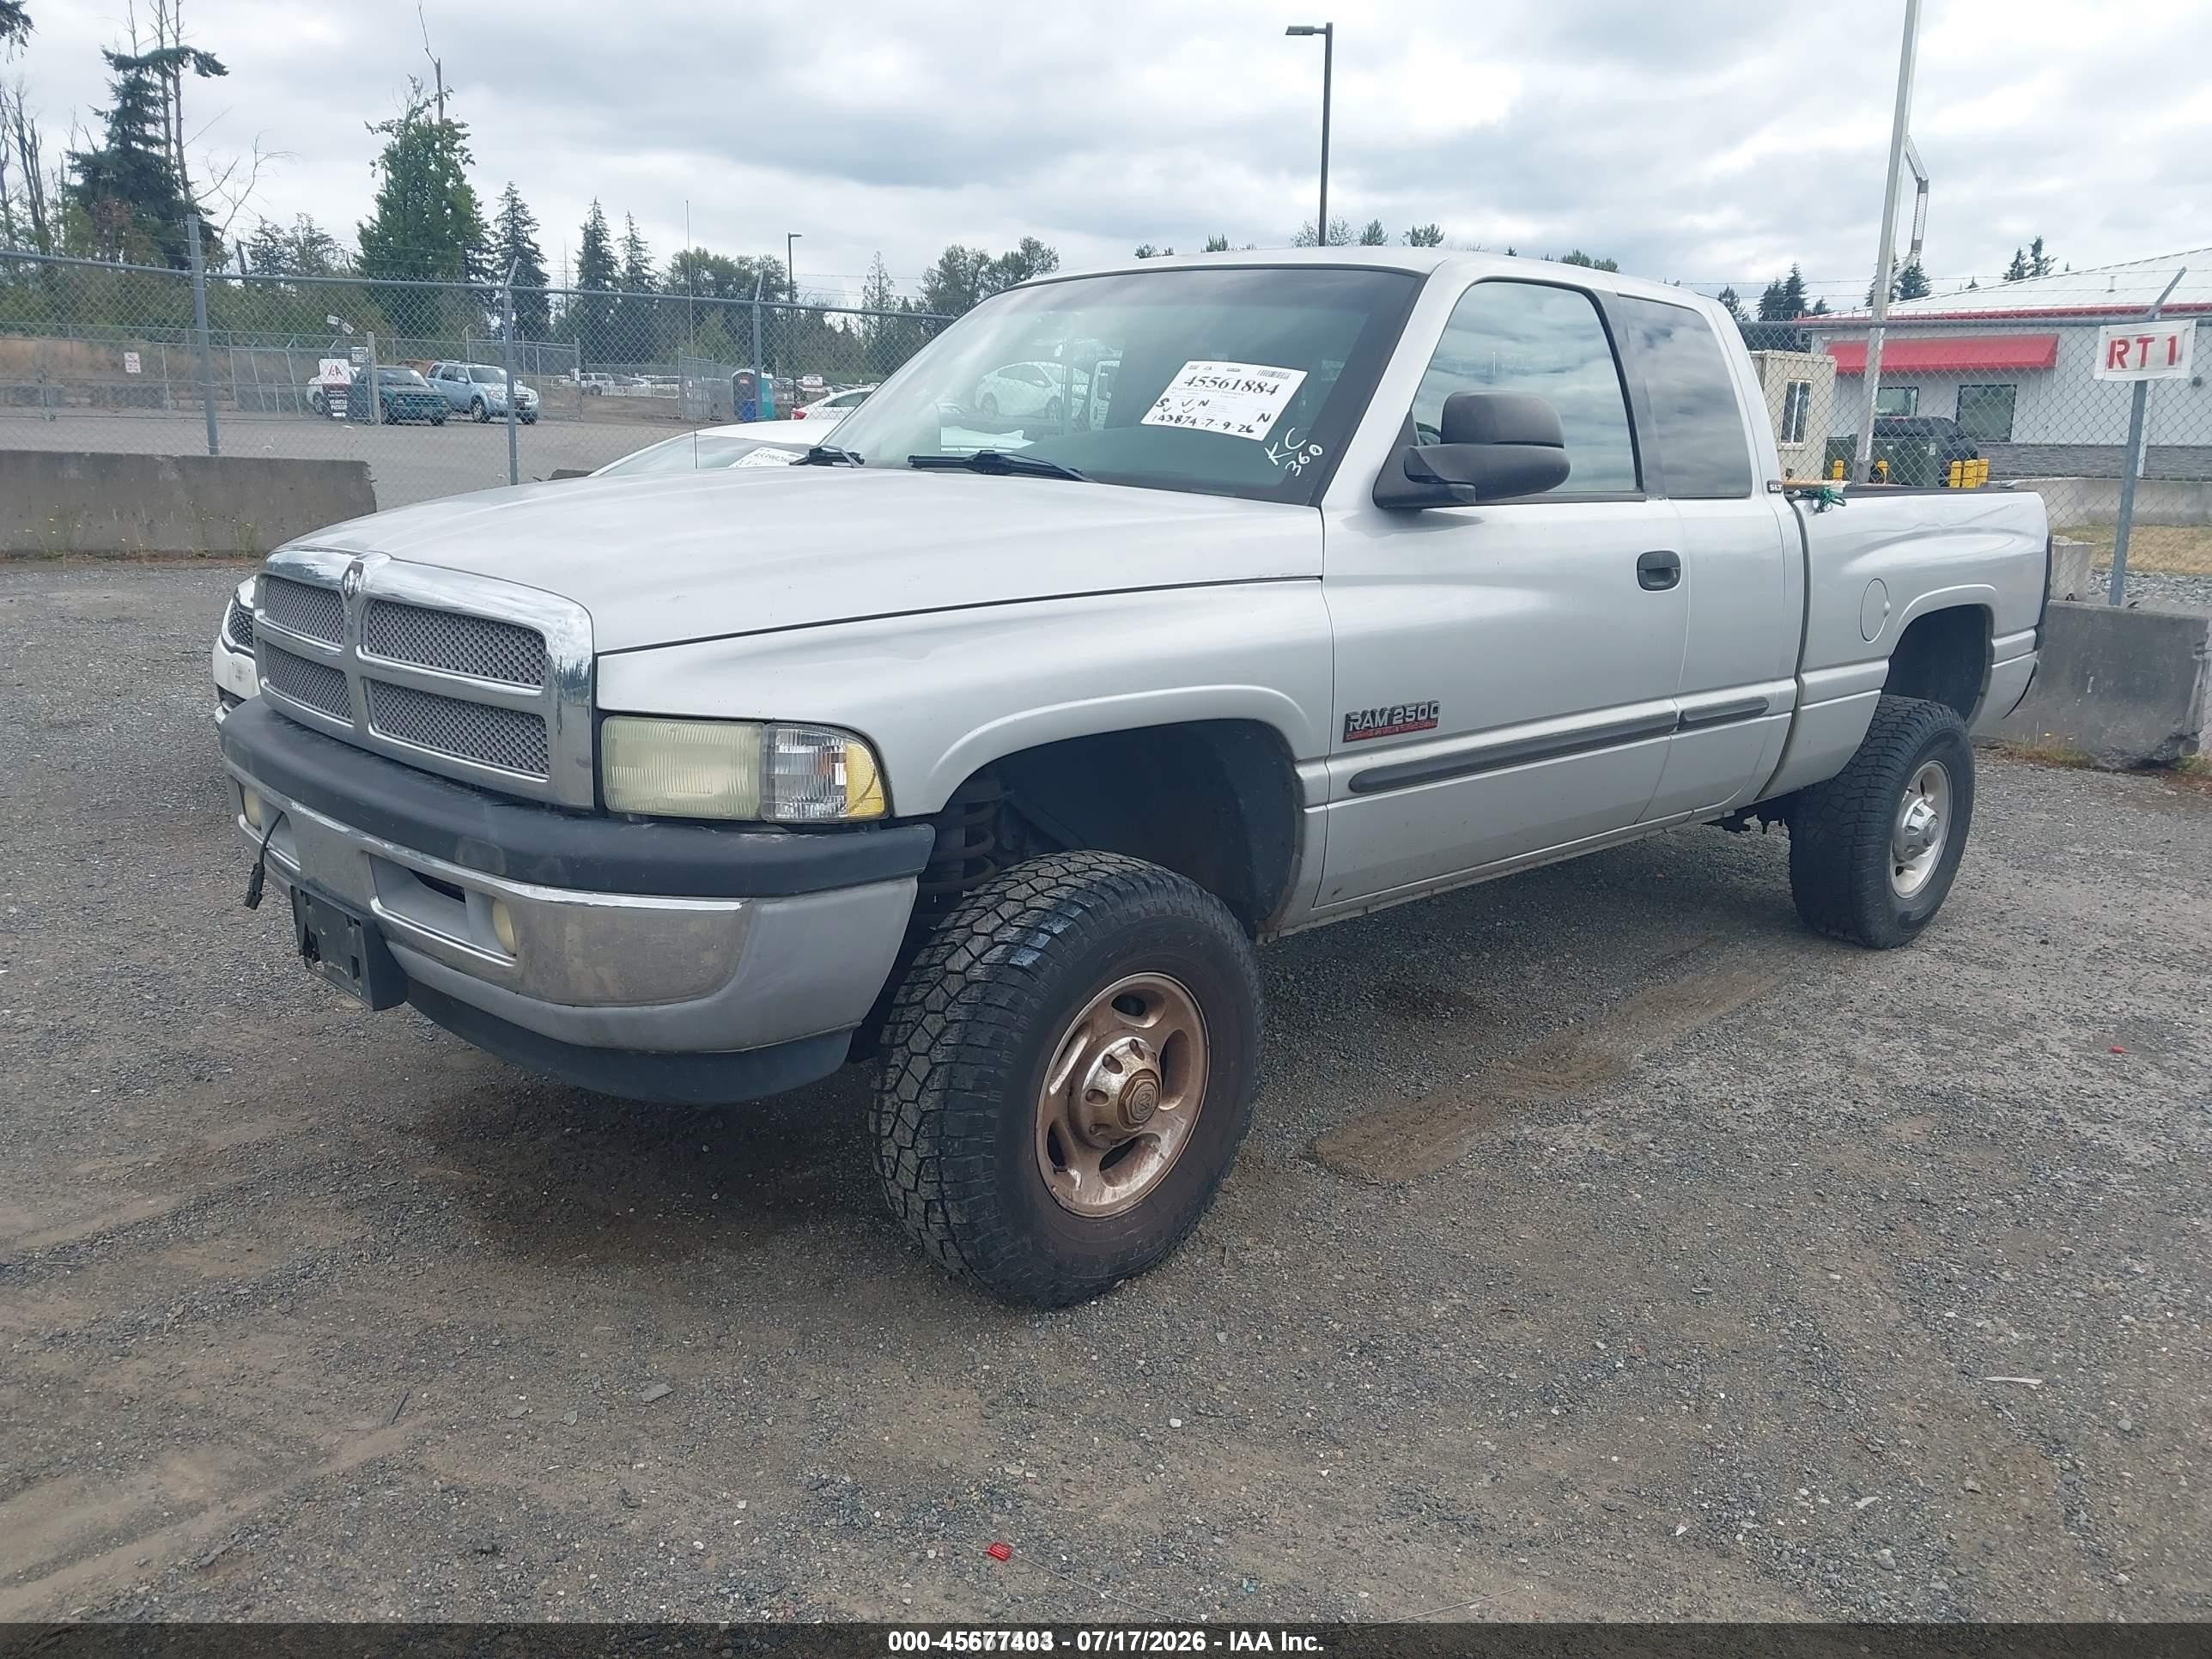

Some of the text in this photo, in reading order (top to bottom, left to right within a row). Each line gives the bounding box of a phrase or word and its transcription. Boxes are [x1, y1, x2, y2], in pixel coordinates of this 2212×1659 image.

[2108, 336, 2178, 369] RT 1
[1183, 374, 1280, 396] 45561884
[1348, 711, 1389, 732] RAM
[1392, 702, 1441, 725] 2500
